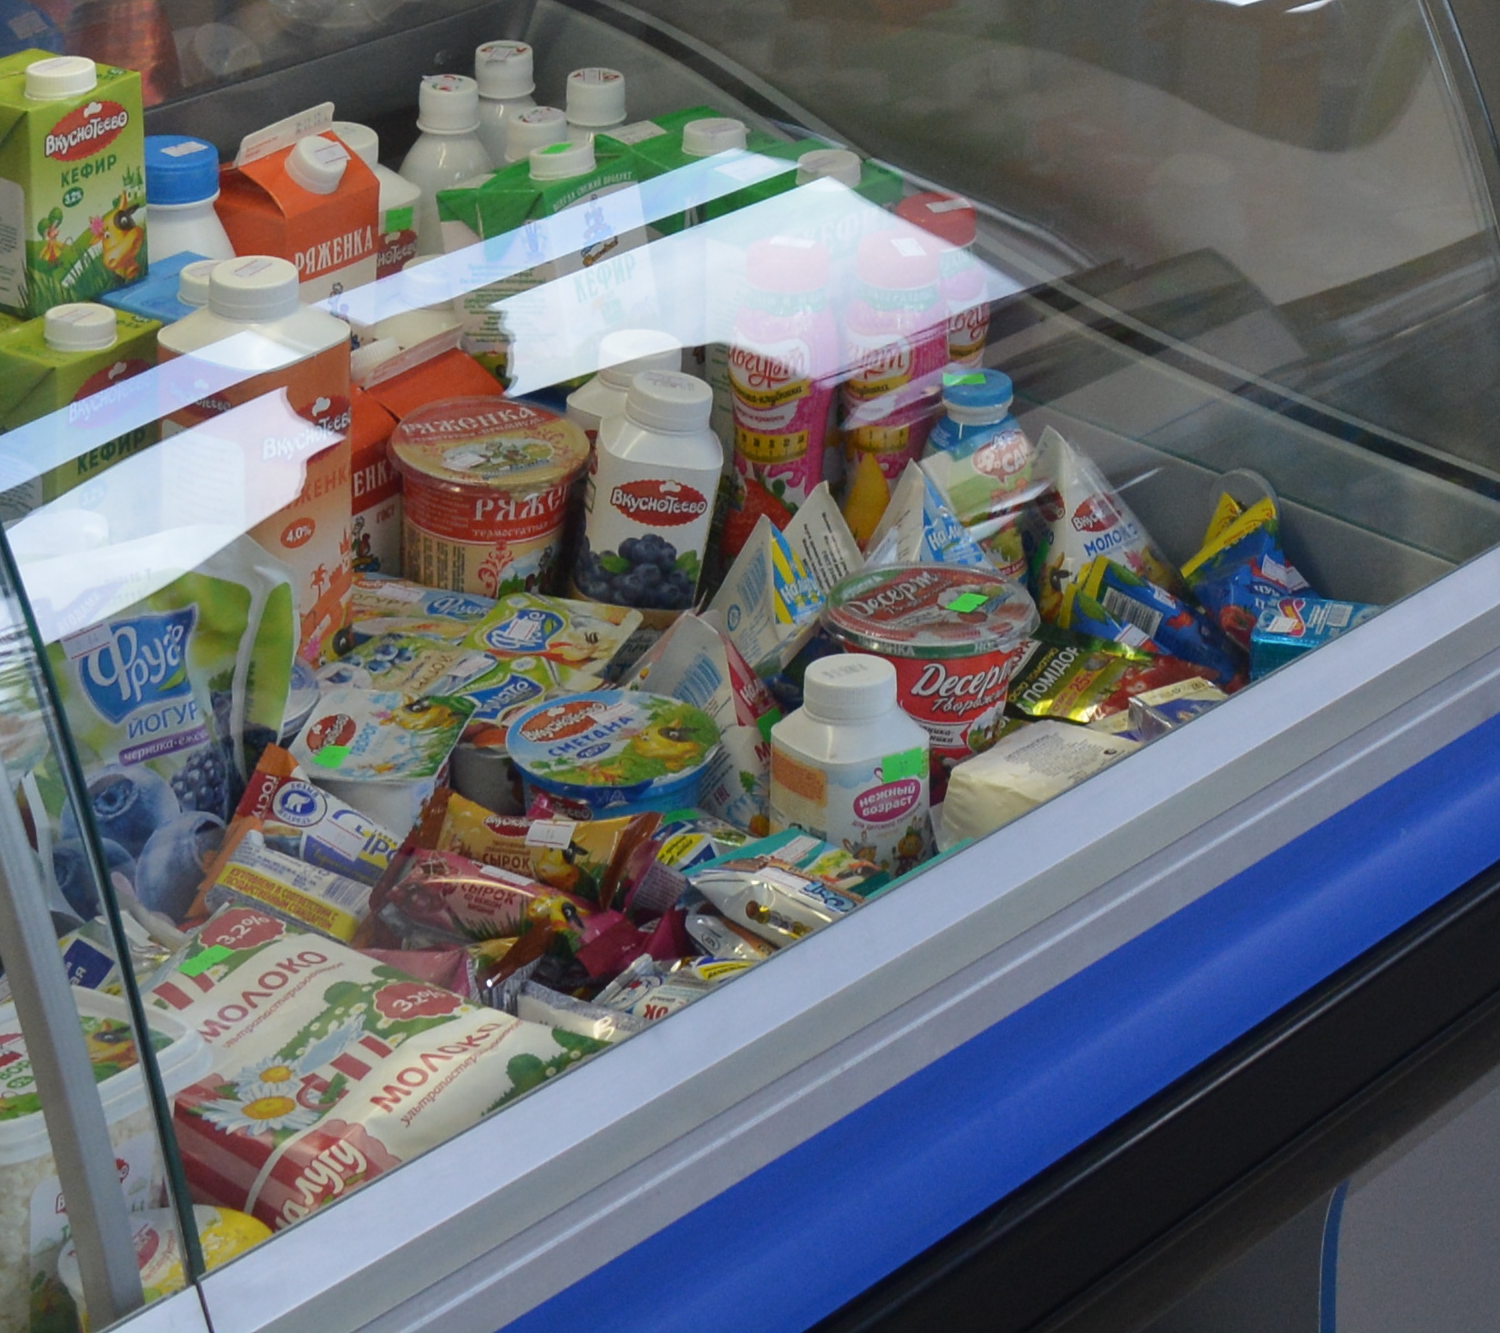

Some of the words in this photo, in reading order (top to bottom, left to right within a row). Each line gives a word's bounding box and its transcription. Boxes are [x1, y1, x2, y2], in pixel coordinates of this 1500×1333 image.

[60, 154, 118, 189] КЕФИР
[295, 224, 374, 275] РЯЖЕНКА
[76, 431, 145, 475] КЕФИР
[127, 700, 200, 741] ЙОГУР
[859, 782, 916, 808] нежный
[215, 913, 271, 949] 3,2%
[200, 949, 328, 1042] МОЛОКО
[393, 986, 446, 1020] 3,2%
[372, 1023, 501, 1113] МОЛОКО
